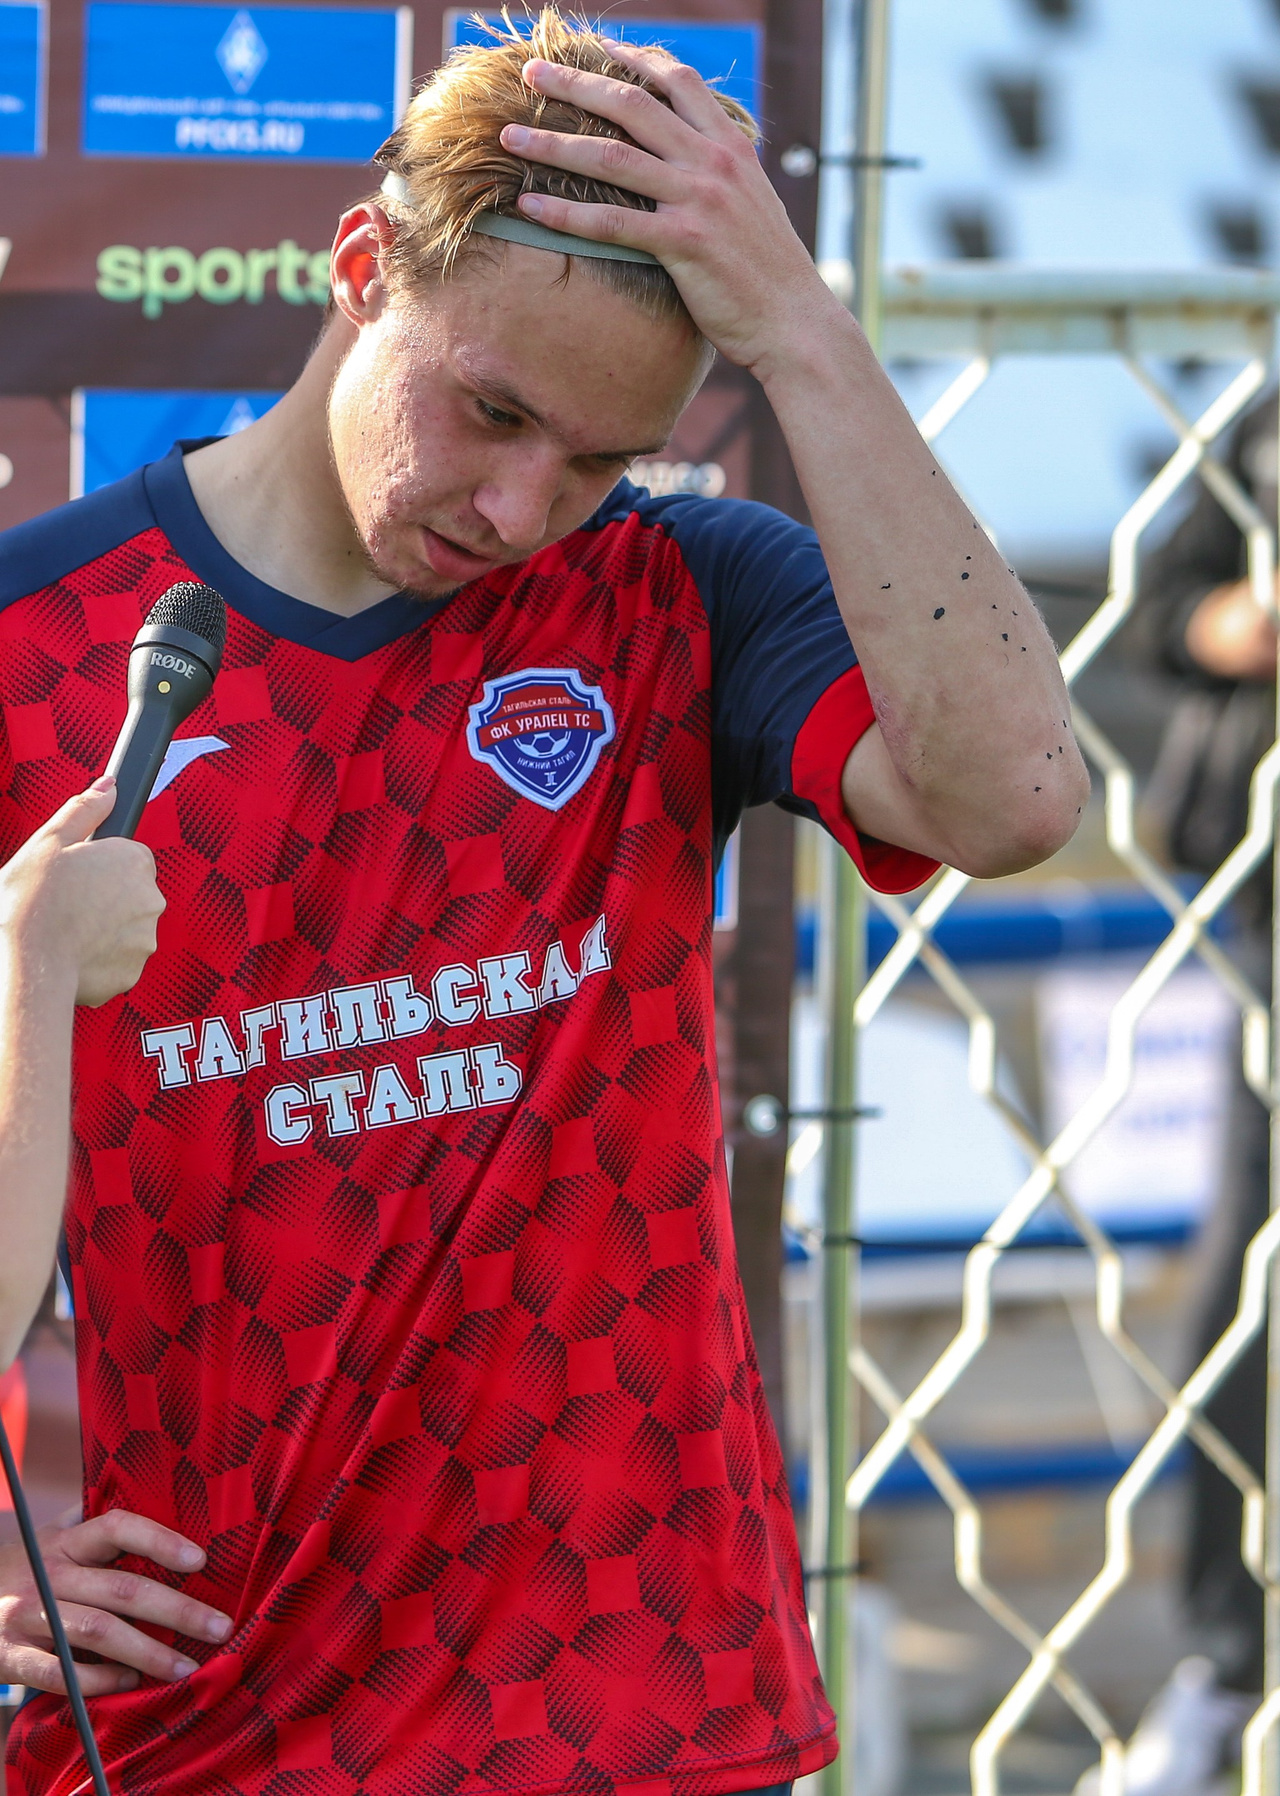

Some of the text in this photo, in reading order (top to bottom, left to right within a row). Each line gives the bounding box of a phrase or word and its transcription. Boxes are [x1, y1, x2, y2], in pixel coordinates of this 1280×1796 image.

[150, 652, 197, 680] RØDE
[502, 696, 572, 714] ТАГИЛЬСКАЯ СТАЛЬ
[490, 713, 591, 740] ФК УРАЛЕЦ ТС
[517, 750, 576, 770] НИЖНИЙ ТАГИЛ
[140, 913, 611, 1090] ТАГИЛЬСКАЯ
[264, 1043, 523, 1147] СТАЛЬ
